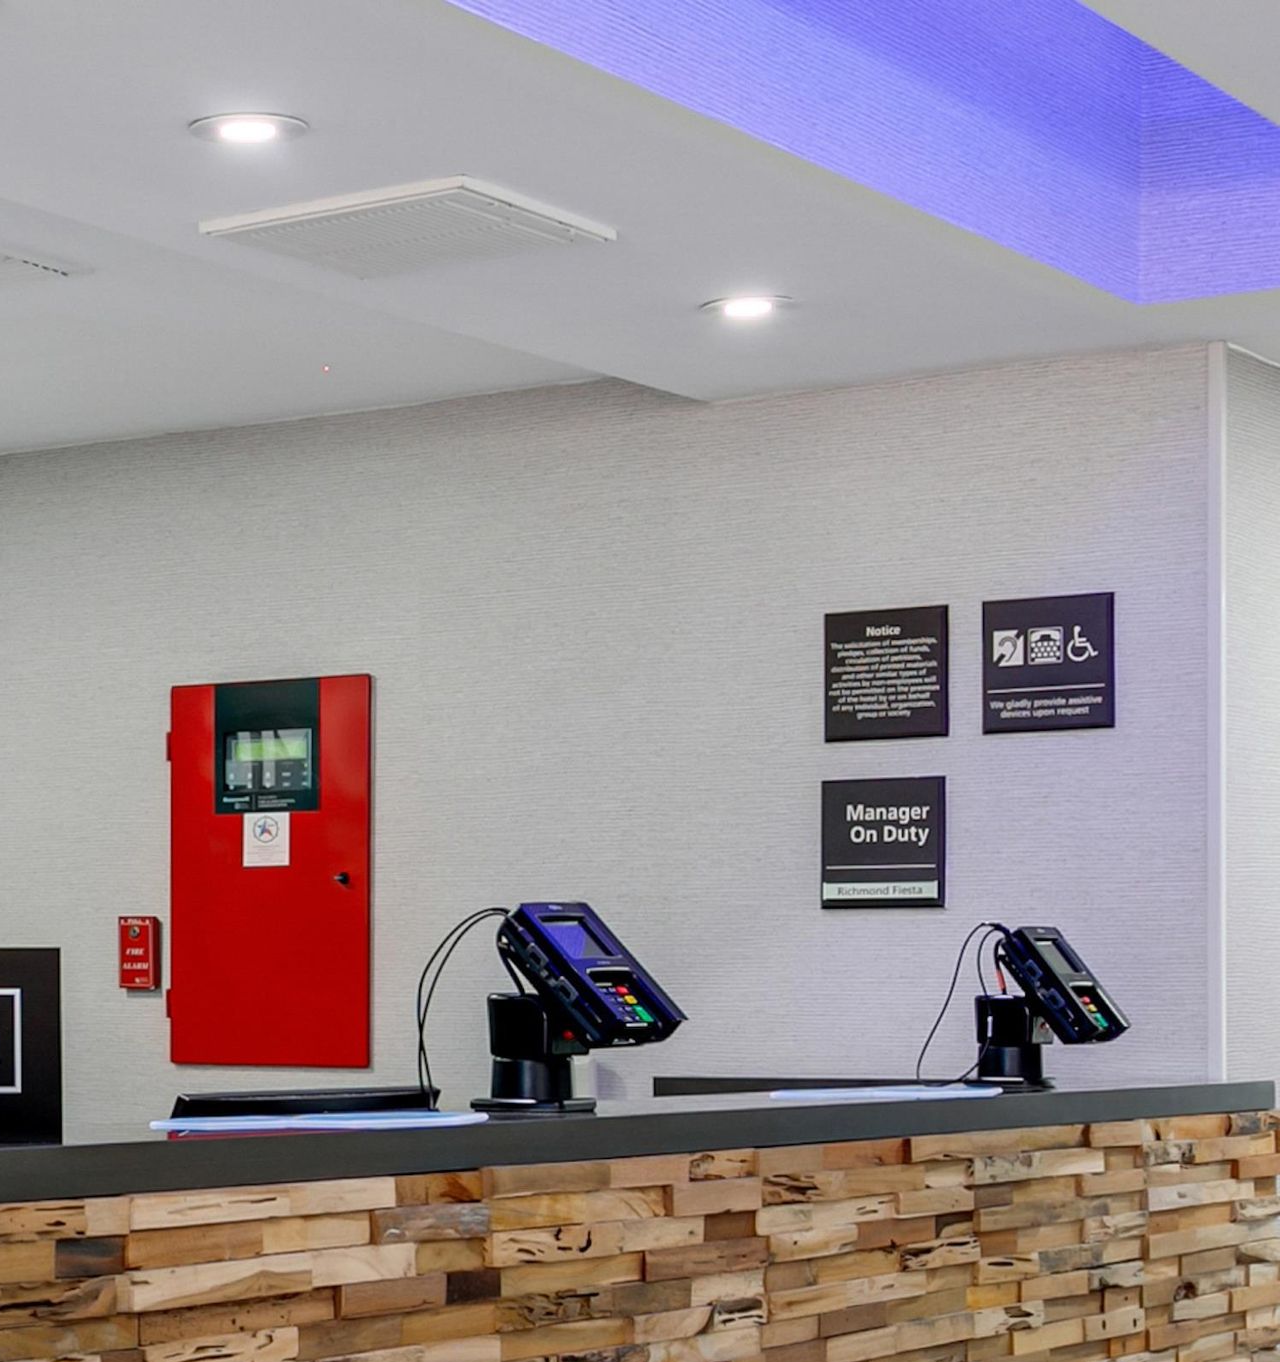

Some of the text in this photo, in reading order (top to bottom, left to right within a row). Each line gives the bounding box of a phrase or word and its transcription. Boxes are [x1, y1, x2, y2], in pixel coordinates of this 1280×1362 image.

[866, 625, 901, 637] Notice
[990, 696, 1103, 710] We gladly provide assistive
[1000, 706, 1090, 718] devices upon request
[846, 804, 930, 824] Manager
[850, 825, 929, 846] On Duty
[837, 885, 924, 896] Richmond Fiesta
